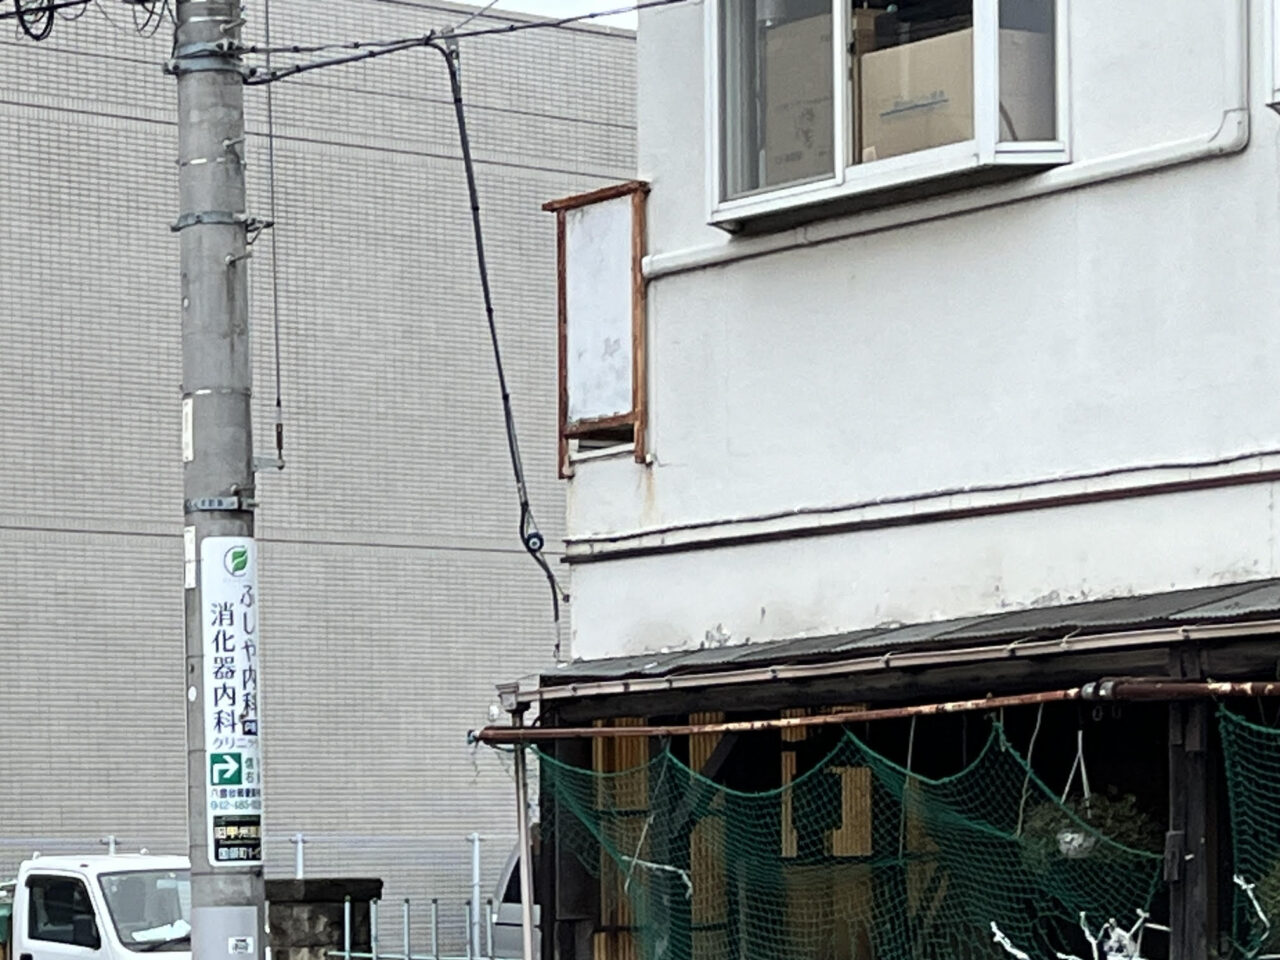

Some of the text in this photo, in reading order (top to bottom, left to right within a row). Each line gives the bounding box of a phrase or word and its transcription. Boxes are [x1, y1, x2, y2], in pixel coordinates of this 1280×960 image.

[211, 601, 238, 734] 消化器内科
